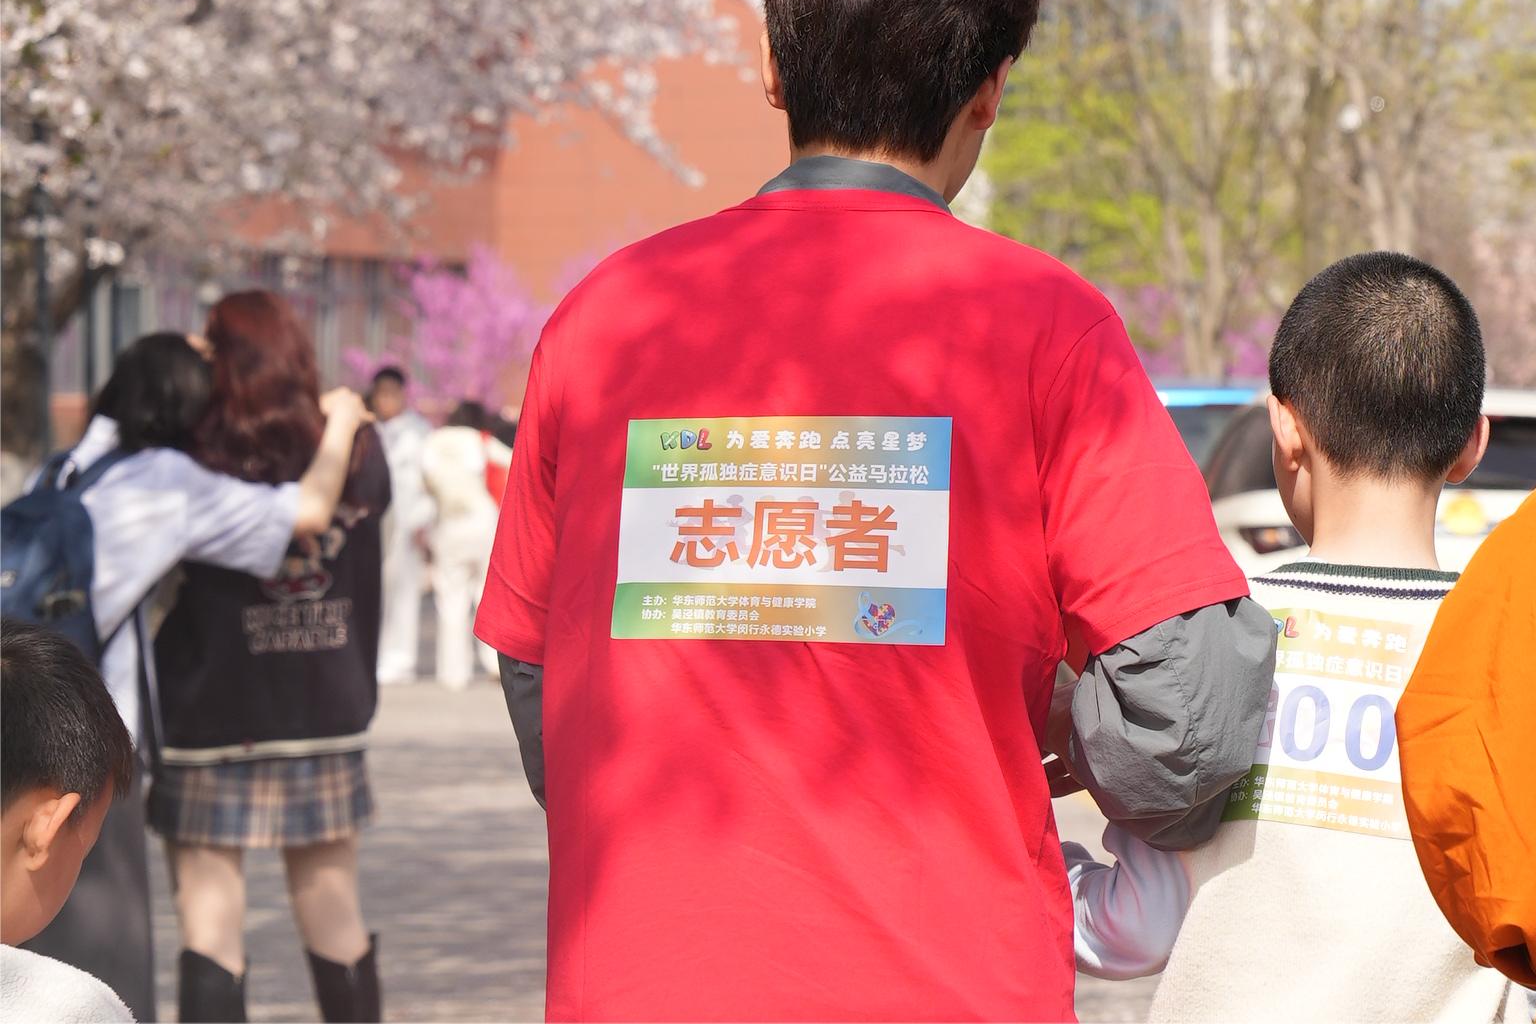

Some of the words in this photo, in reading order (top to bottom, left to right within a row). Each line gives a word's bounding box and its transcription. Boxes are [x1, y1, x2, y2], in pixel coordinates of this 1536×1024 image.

[660, 427, 713, 451] KDL
[726, 430, 822, 450] 为爱奔跑
[830, 430, 928, 452] 点亮星梦
[669, 499, 898, 573] 志愿者
[672, 595, 817, 609] 华东师范大学体育与健康学院
[670, 622, 827, 637] 华东师范大学闵行永德实验小学
